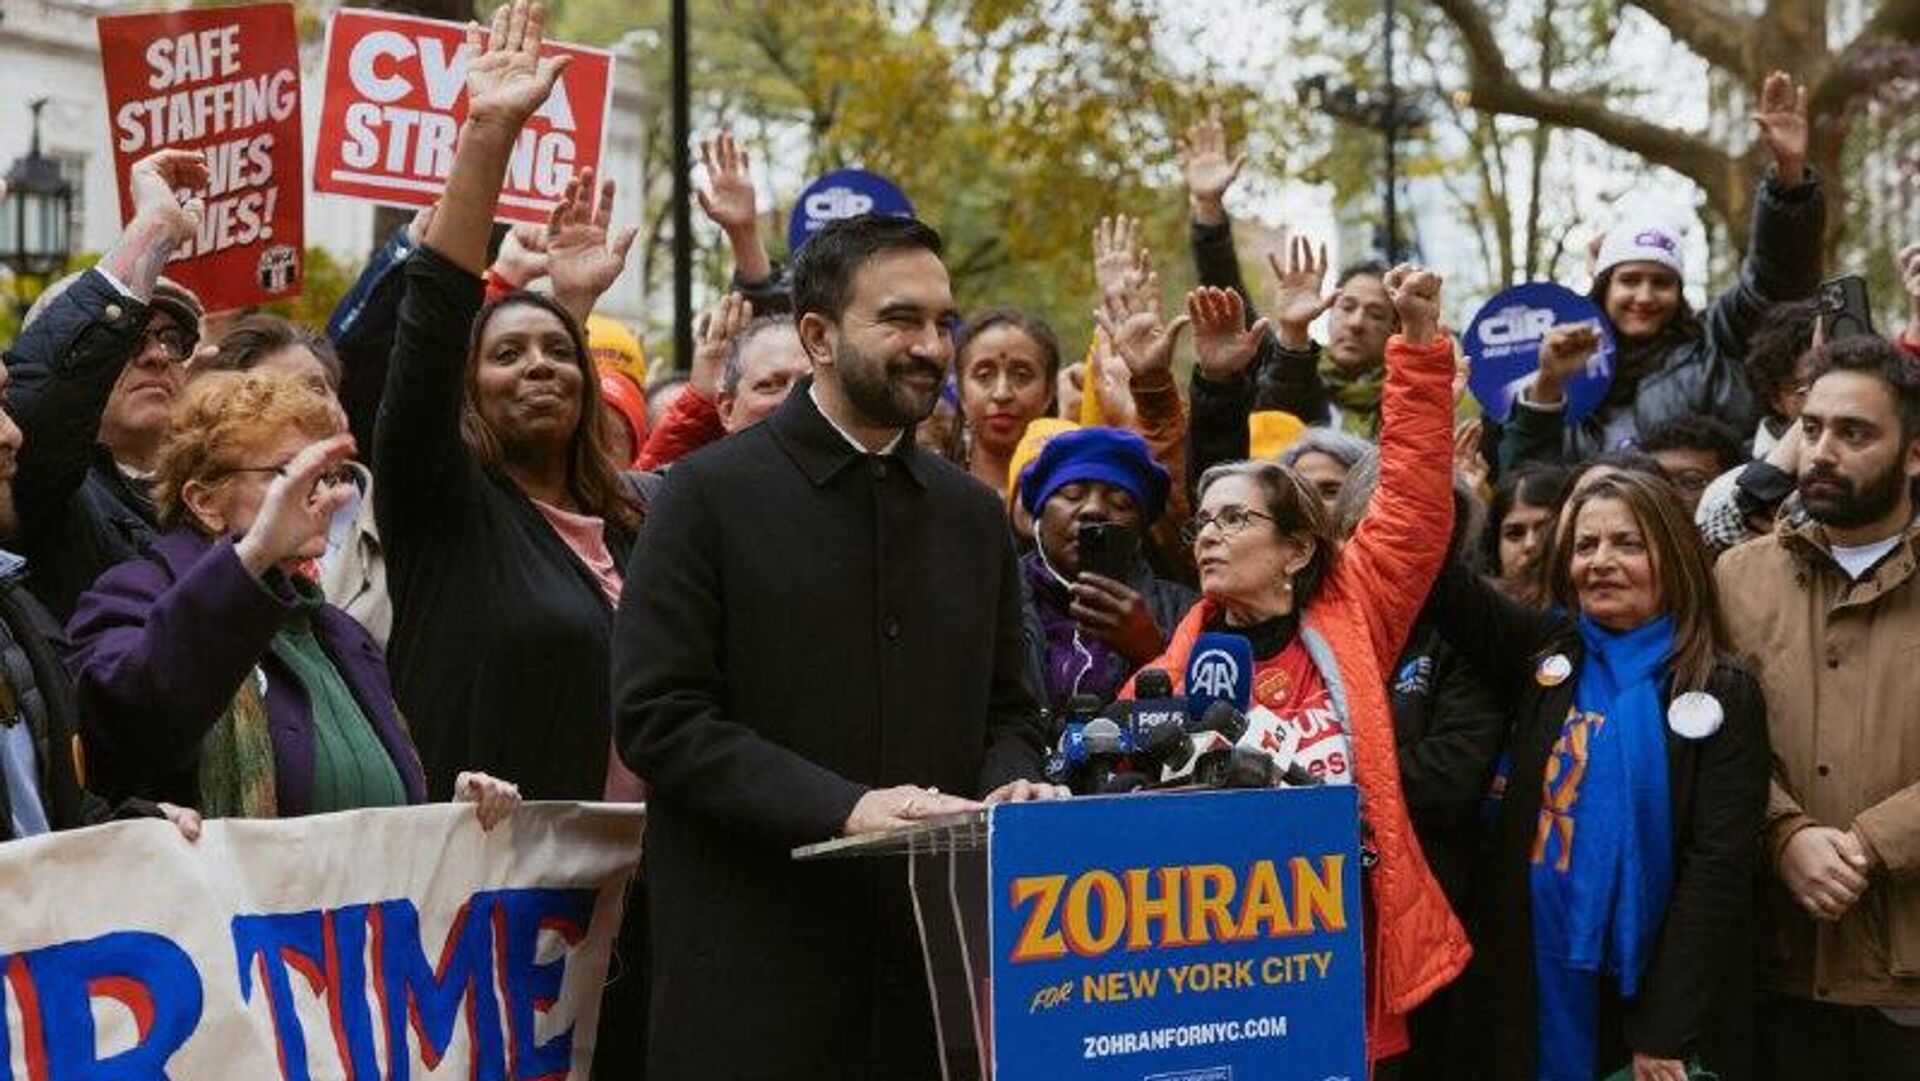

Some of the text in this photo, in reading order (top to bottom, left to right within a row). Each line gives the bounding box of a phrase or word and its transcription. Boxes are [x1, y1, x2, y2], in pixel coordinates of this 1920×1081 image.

[146, 24, 241, 90] SAFE
[116, 69, 297, 153] STAFFING
[341, 103, 576, 197] STRNG
[168, 187, 279, 262] VES!
[1190, 662, 1235, 698] AA
[1009, 854, 1347, 963] ZOHRAN
[231, 886, 600, 1081] TIME
[1083, 968, 1161, 1003] NEW
[1166, 960, 1255, 994] YORK
[1261, 952, 1333, 986] CITY
[1083, 1016, 1287, 1059] ZOHRANFORNYC.COM
